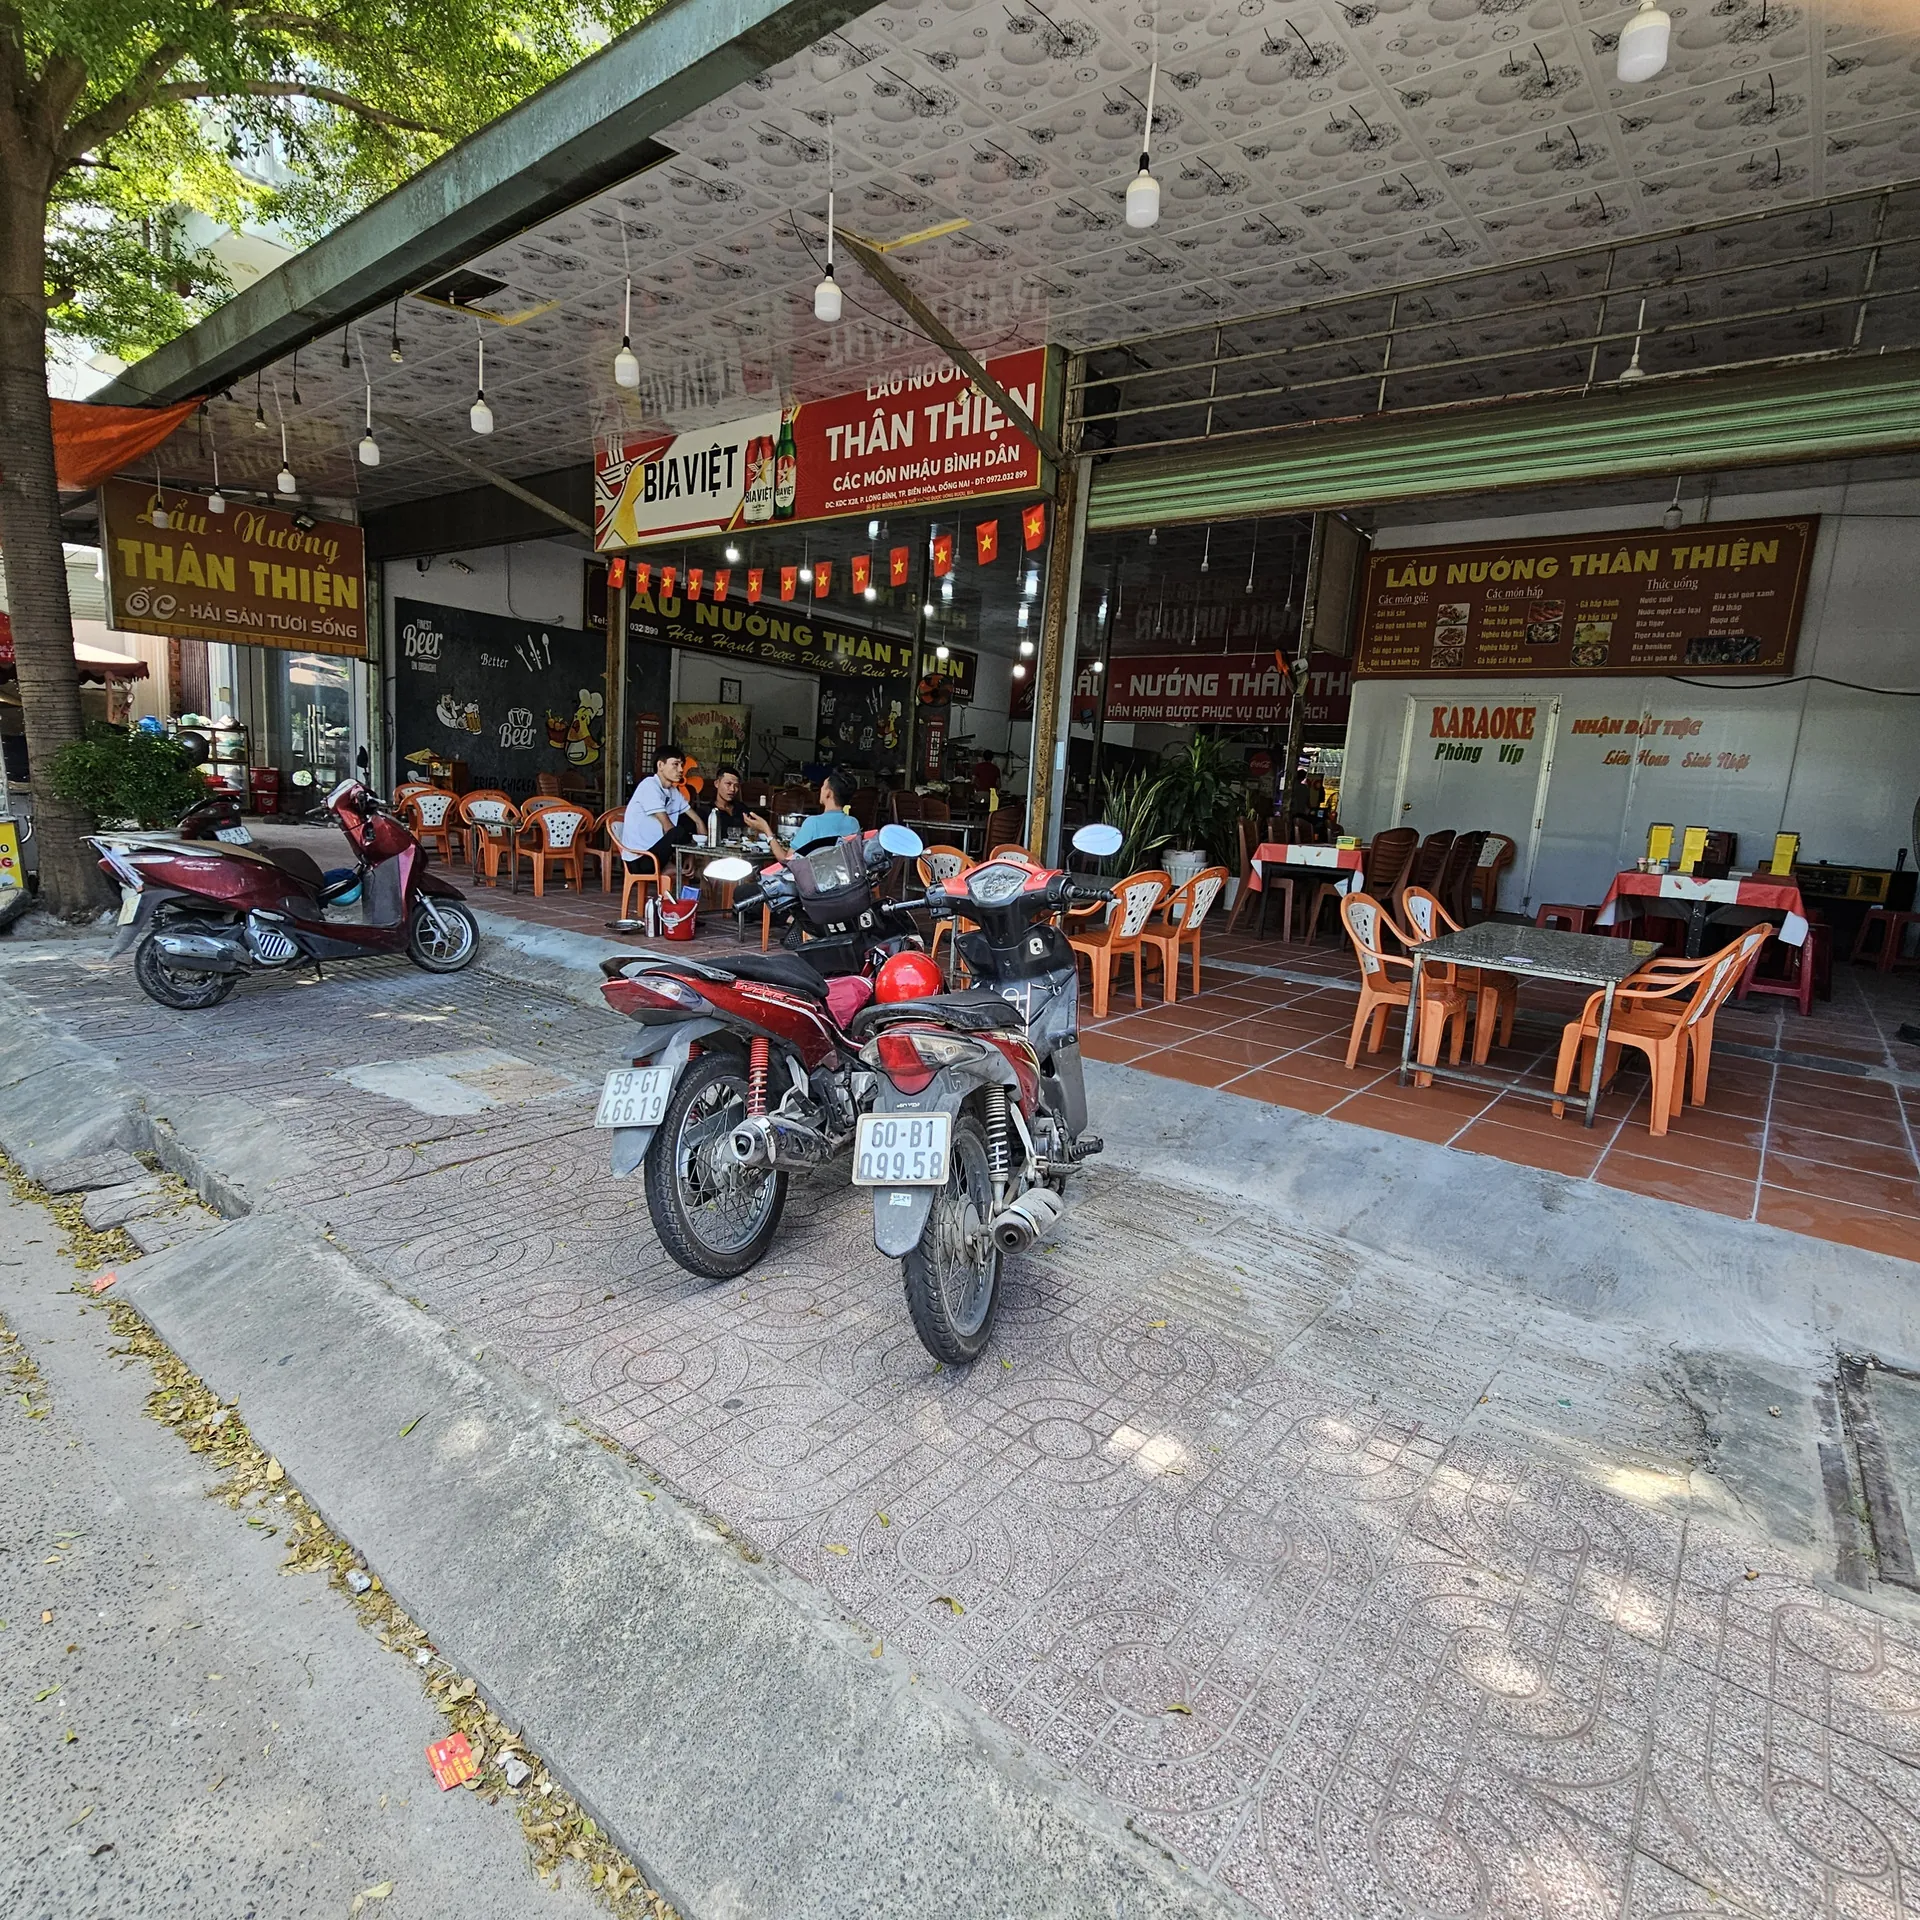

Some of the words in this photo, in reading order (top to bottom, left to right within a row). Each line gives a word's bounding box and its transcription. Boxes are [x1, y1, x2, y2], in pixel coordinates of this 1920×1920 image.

[826, 408, 914, 461] THÂN
[924, 382, 1036, 443] THIỆN
[833, 472, 861, 491] CÁC
[864, 466, 896, 487] MÓN
[900, 458, 940, 481] NHẬU
[945, 450, 980, 473] BÌNH
[985, 444, 1020, 466] DÂN
[865, 493, 881, 502] LONG
[898, 490, 906, 498] TP.
[908, 486, 921, 496] BIÊN
[922, 484, 937, 494] HÒA,
[958, 479, 970, 488] NAI
[1015, 470, 1027, 479] 899
[117, 539, 236, 592] THÂN
[249, 561, 358, 614] THIỆN
[1386, 559, 1436, 588] LẨU
[1447, 555, 1560, 585] NƯỚNG
[1570, 546, 1660, 577] THÂN
[1671, 537, 1780, 573] THIỆN
[1486, 587, 1502, 599] Các
[1505, 586, 1524, 597] món
[1526, 584, 1544, 599] hấp
[1647, 578, 1671, 590] Thức
[1674, 575, 1699, 590] uống
[1378, 594, 1393, 605] Các
[1395, 593, 1412, 604] món
[190, 602, 220, 622] HẢI
[225, 604, 264, 627] SẢN
[267, 614, 308, 632] TƯƠI
[311, 617, 358, 638] SỐNG
[695, 602, 814, 647] NƯỚNG
[823, 630, 892, 664] THÂN
[402, 624, 444, 657] Beer
[480, 652, 509, 669] Better
[1129, 667, 1220, 697] NƯỚNG
[1107, 703, 1131, 717] HÂN
[1132, 705, 1164, 720] HẠNH
[1166, 705, 1198, 720] ĐƯỢC
[1202, 705, 1233, 720] PHỤC
[1236, 706, 1253, 721] VỤ
[1256, 703, 1282, 719] QUÝ
[1285, 703, 1329, 719] KÁCH
[1430, 706, 1537, 740] KARAOKE
[1571, 715, 1623, 738] NHẬN
[499, 722, 537, 749] Beer
[1434, 743, 1483, 764] Phòng
[1498, 744, 1525, 765] Víp
[1602, 750, 1631, 765] Liên
[1636, 749, 1671, 766] Hoan
[1681, 752, 1712, 768] Sinh
[860, 1151, 943, 1180] 099.58
